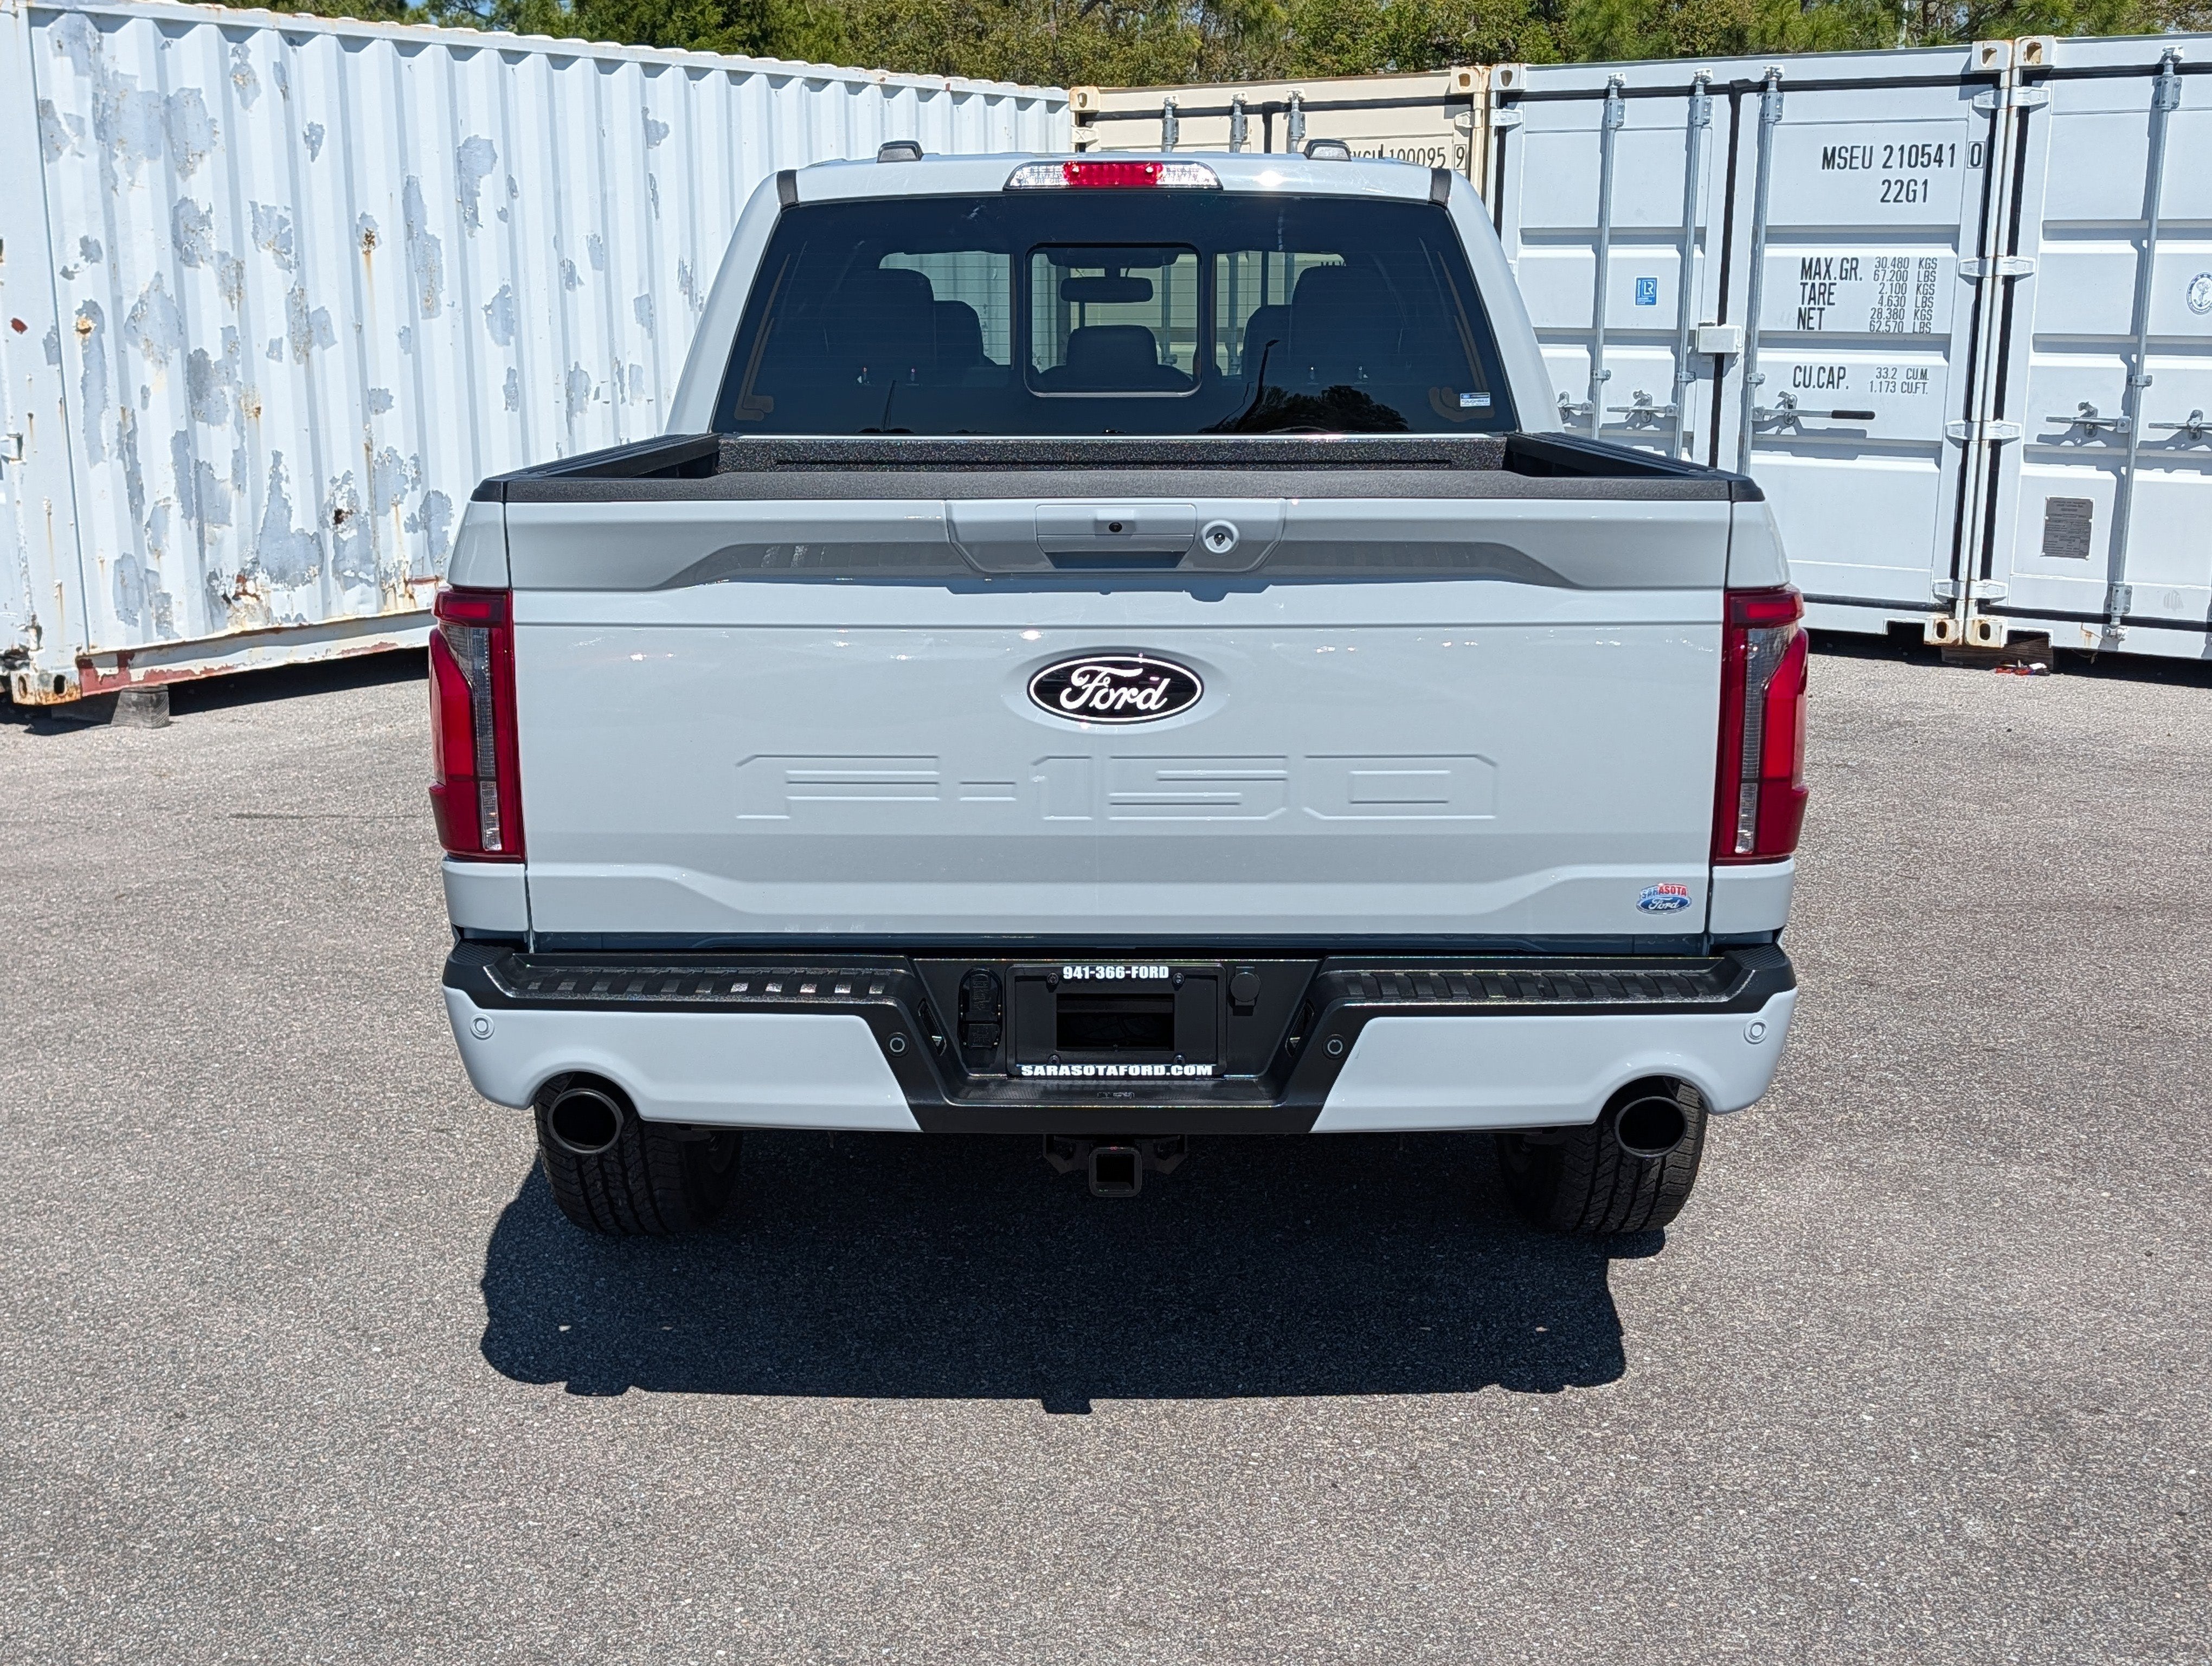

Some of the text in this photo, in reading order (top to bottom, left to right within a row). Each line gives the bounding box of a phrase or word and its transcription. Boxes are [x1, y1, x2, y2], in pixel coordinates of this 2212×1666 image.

[1456, 146, 1465, 168] 9
[1822, 143, 1983, 170] MSEU 210541 0
[1880, 178, 1928, 203] 22G1
[1874, 257, 1909, 270] 30.480
[1918, 257, 1938, 270] KGS
[1873, 270, 1936, 283] 67.200 LBS
[1800, 282, 1935, 306] TARE 2.100 KGS
[1877, 296, 1934, 309] 4.630 LBS
[1797, 307, 1933, 330] NET 28.380 KGS
[1912, 321, 1931, 334] LBS
[1875, 367, 1897, 380] 33.2
[1869, 380, 1896, 393] 1.173
[1059, 665, 1171, 710] Ford
[736, 754, 1496, 821] F-150
[1640, 886, 1687, 898] SARASOTA
[1648, 898, 1681, 910] Ford
[1063, 966, 1169, 979] 941-366-FORD
[1021, 1065, 1213, 1076] SARASOTAFORD.COM
